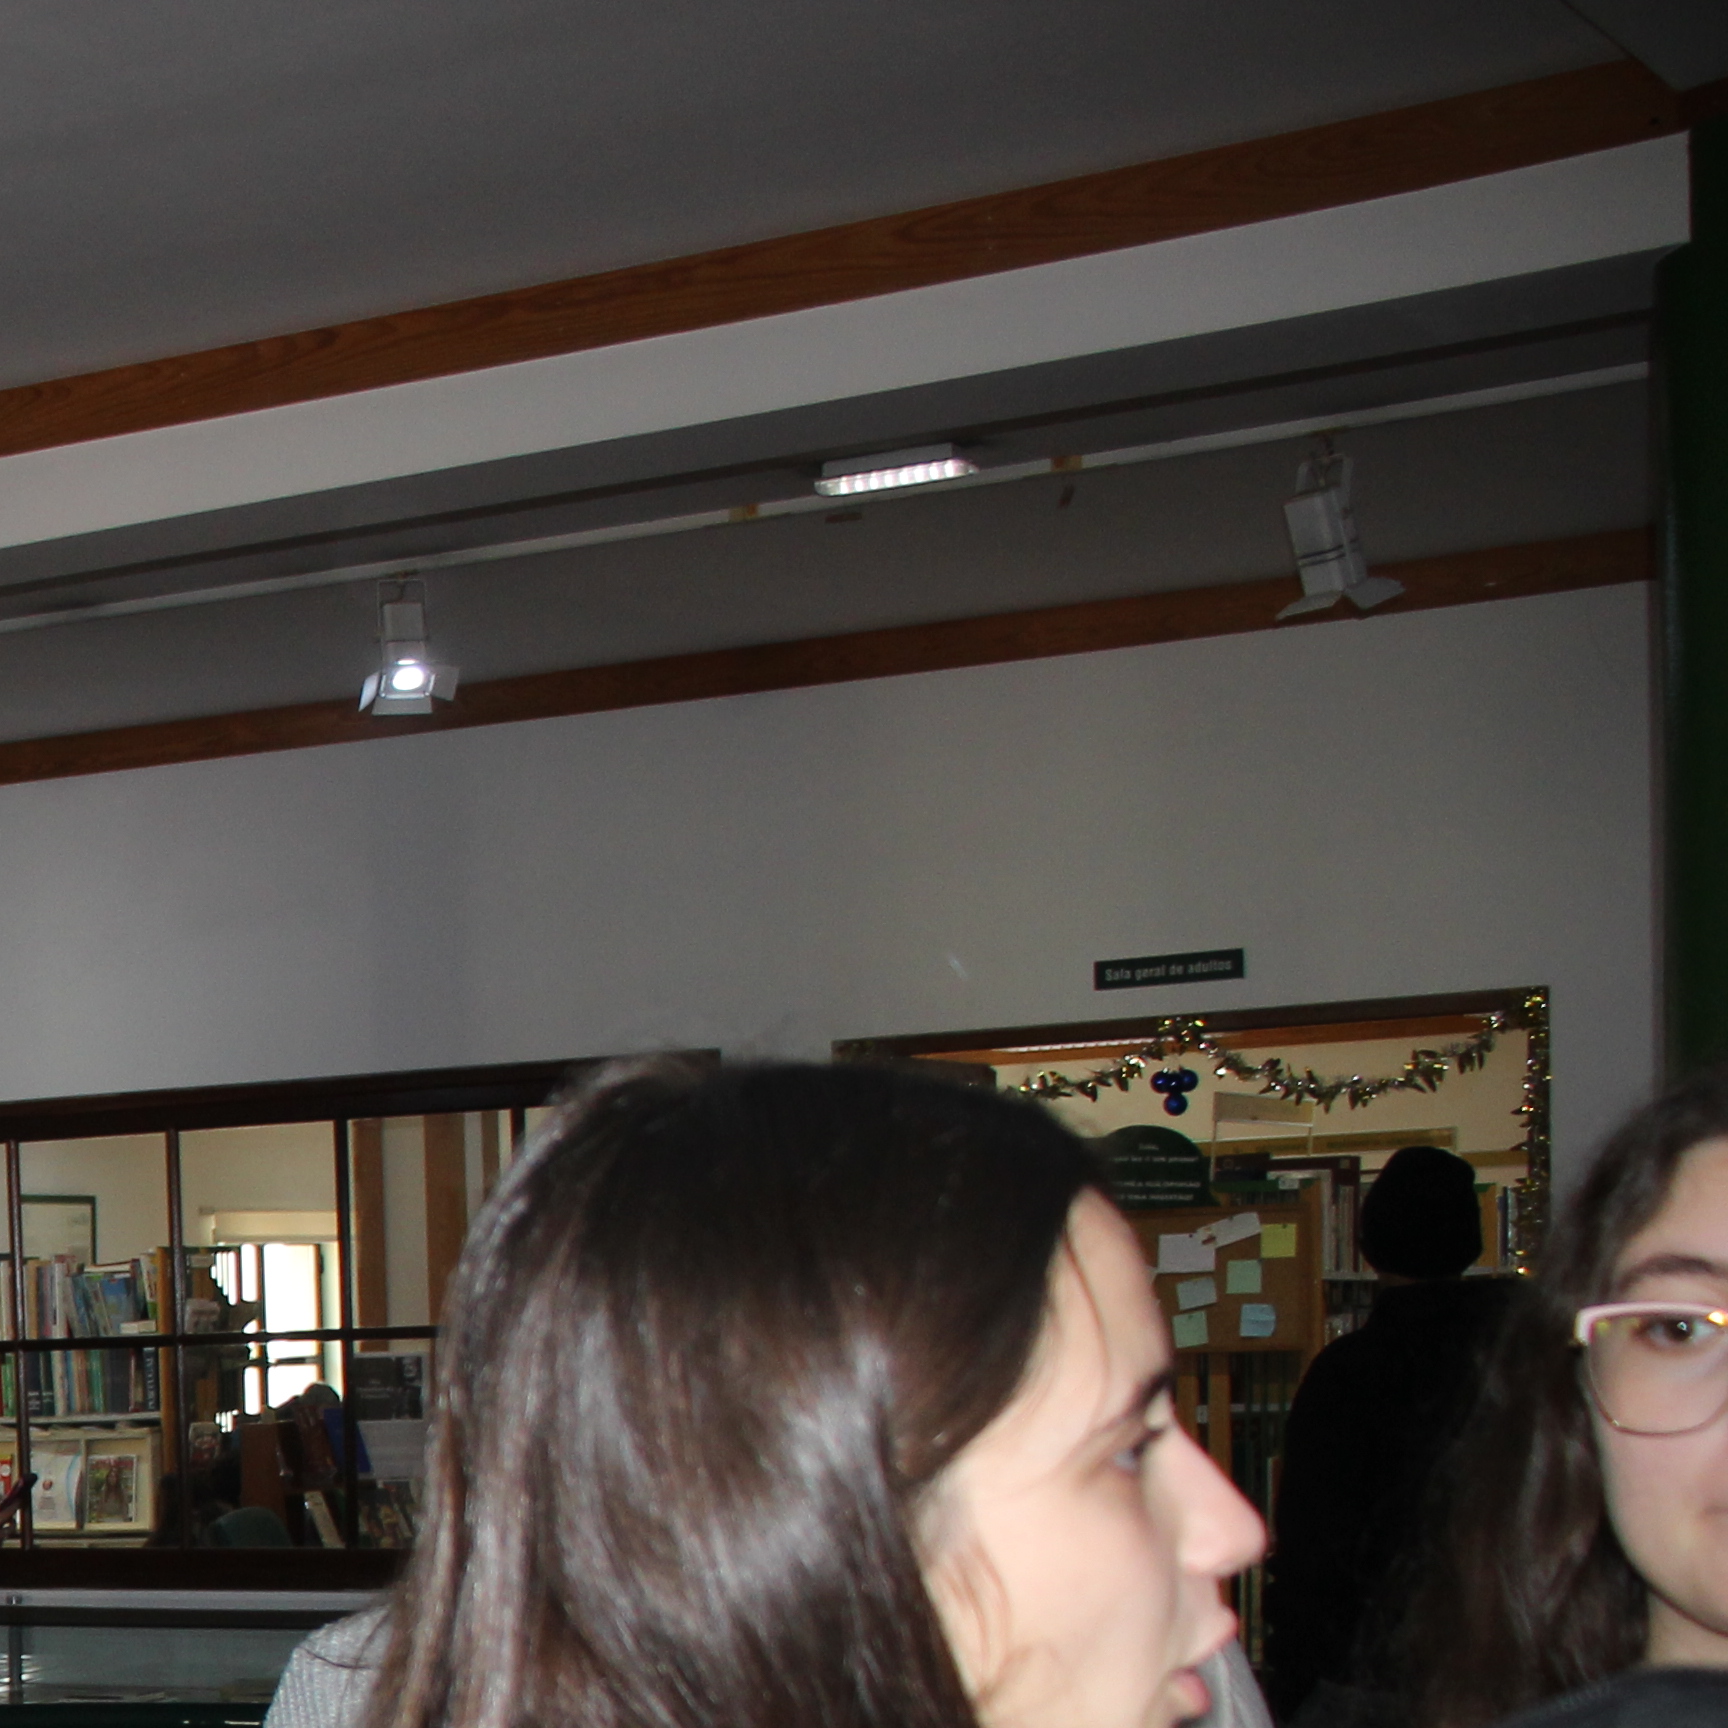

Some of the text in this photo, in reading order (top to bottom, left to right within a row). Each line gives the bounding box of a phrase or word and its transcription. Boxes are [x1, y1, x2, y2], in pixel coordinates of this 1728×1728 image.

[1105, 959, 1233, 981] Sala geral de adultos
